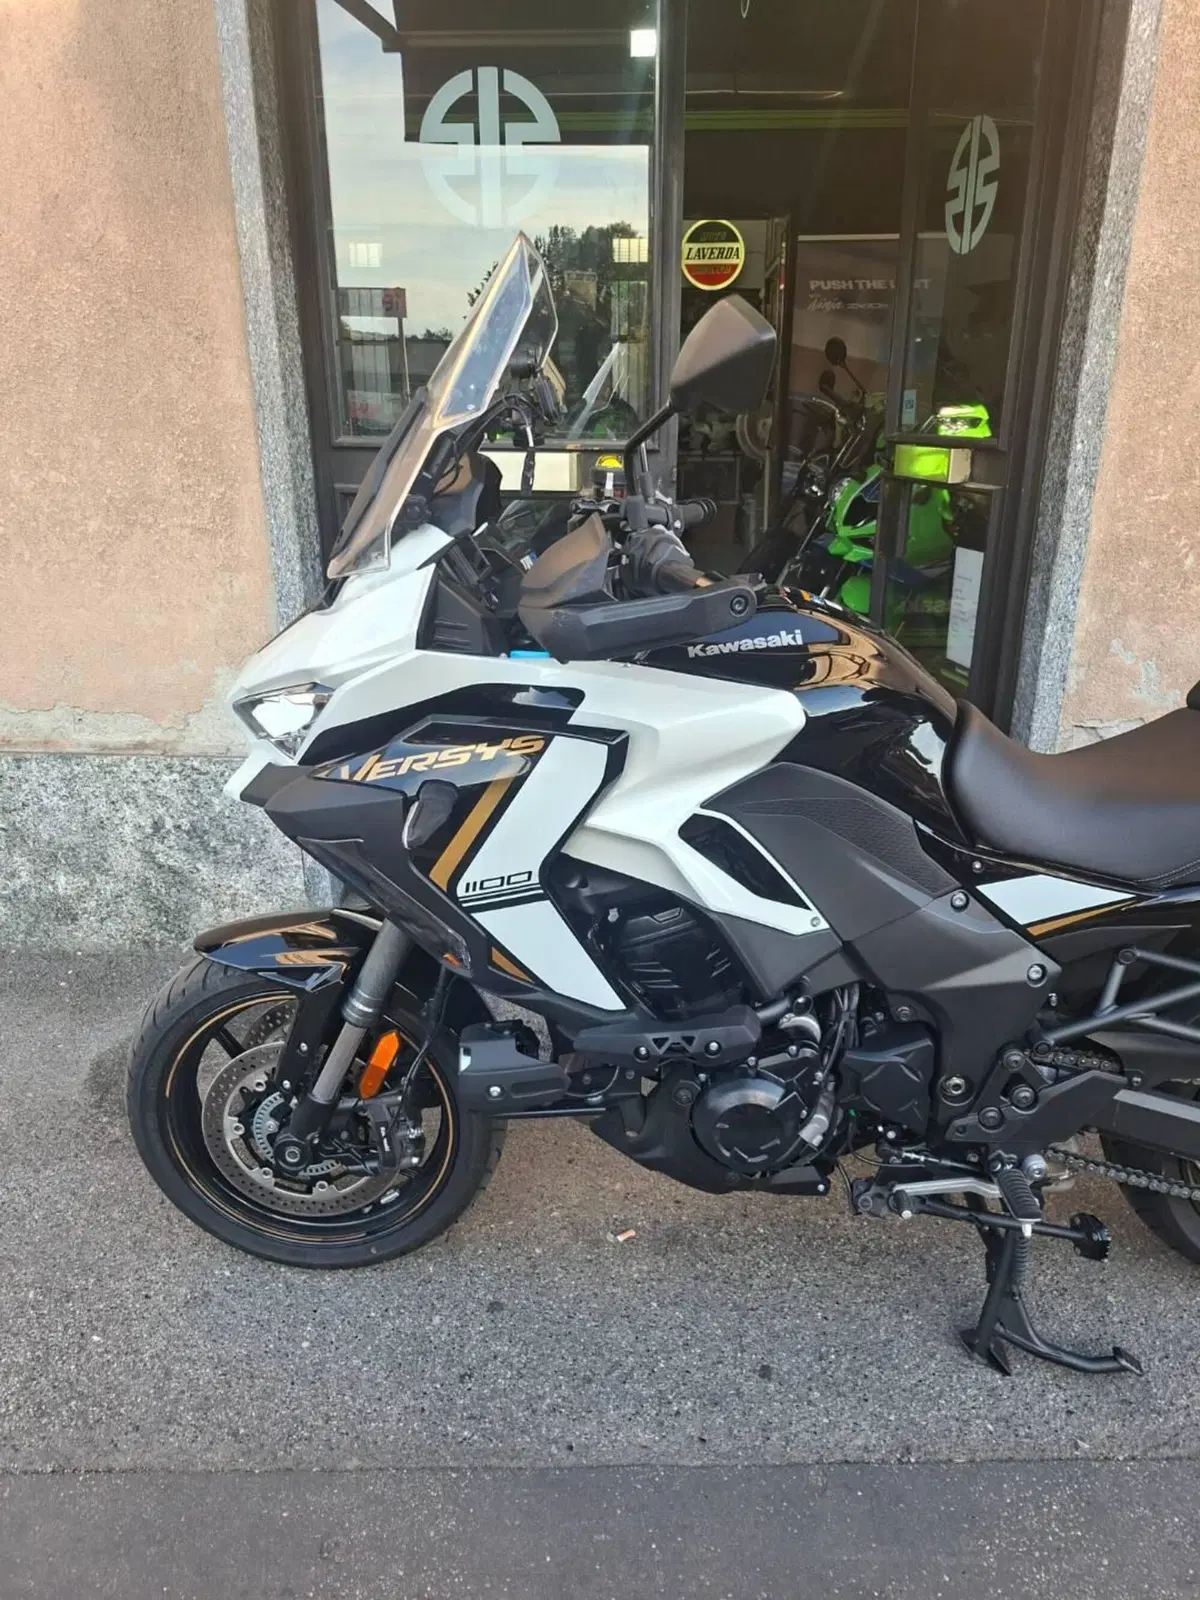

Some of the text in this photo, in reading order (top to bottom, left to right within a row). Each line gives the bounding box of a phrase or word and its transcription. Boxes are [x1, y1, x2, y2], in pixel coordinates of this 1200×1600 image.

[685, 246, 740, 261] LAVERDA
[809, 279, 854, 290] PUSH
[855, 279, 888, 290] THE
[687, 629, 804, 658] Kawasaki
[339, 735, 545, 782] VERSYS
[465, 870, 532, 893] 1100
